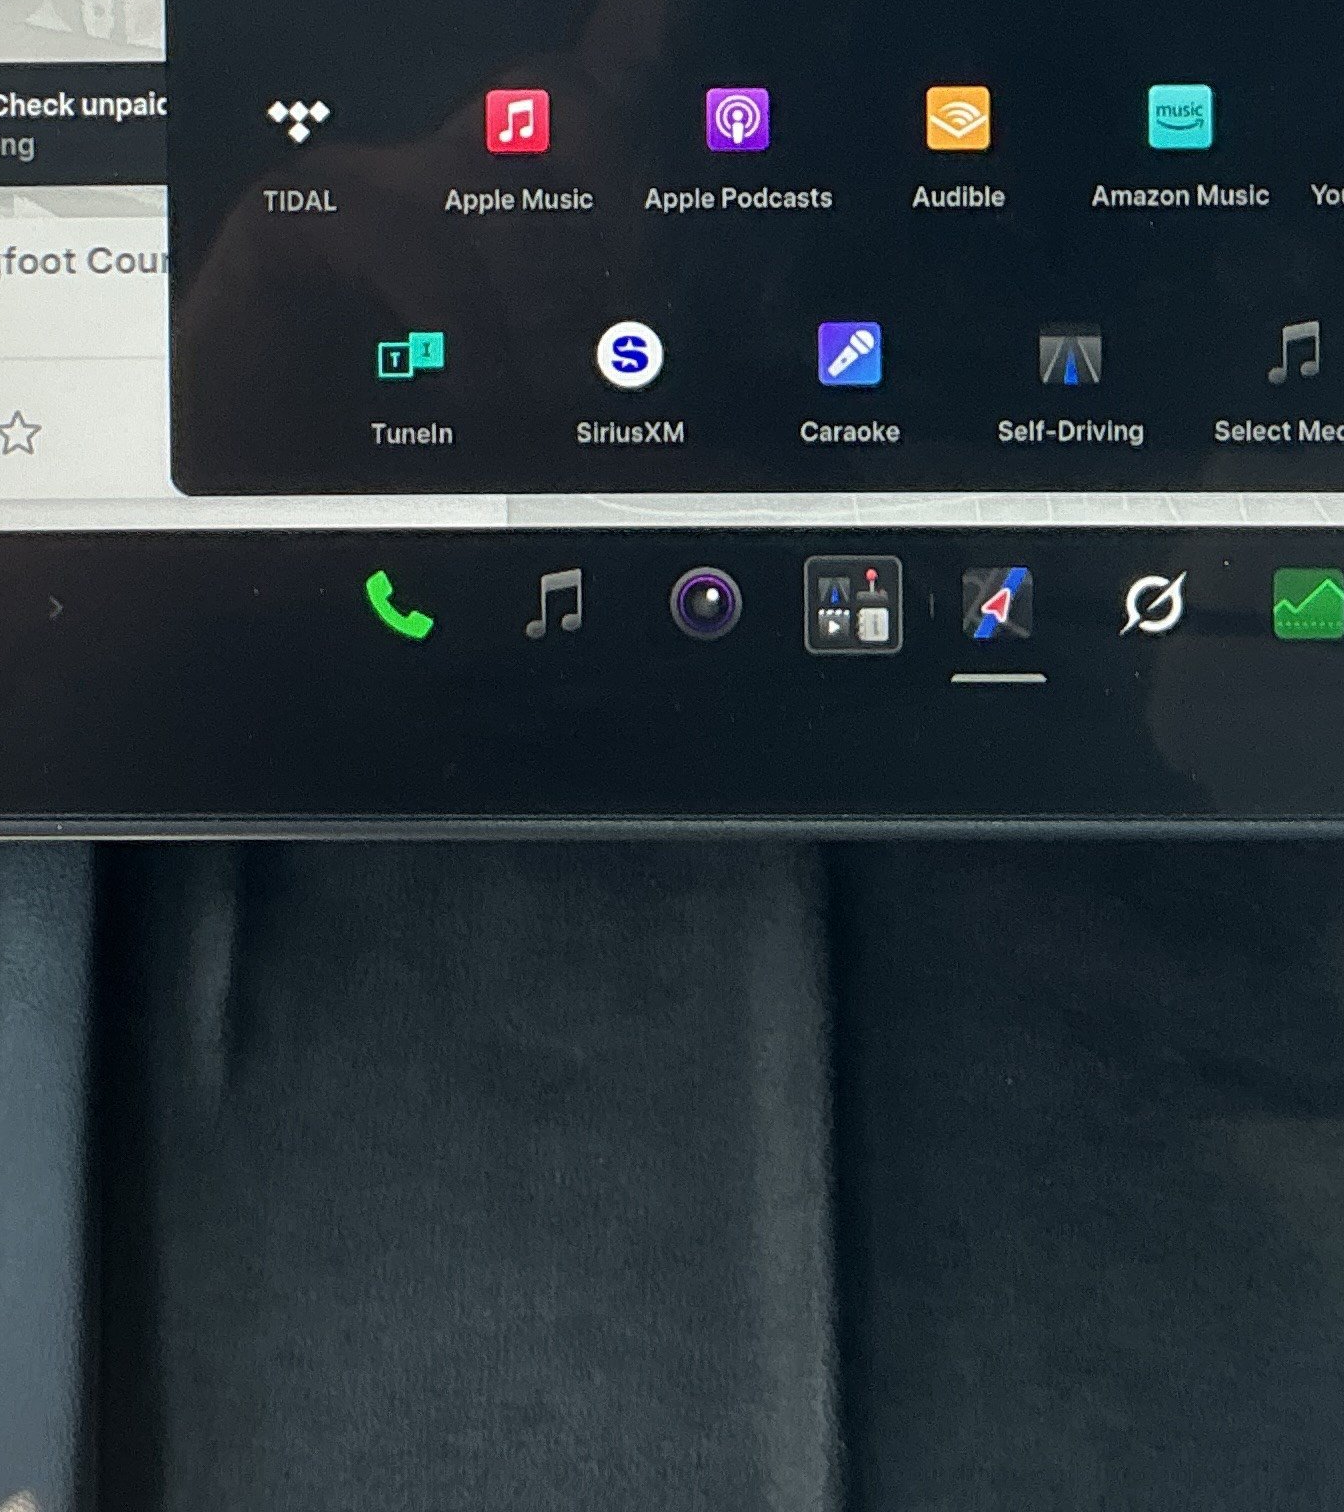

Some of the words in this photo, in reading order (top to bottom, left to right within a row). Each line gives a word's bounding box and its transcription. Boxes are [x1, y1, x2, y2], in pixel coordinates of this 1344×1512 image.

[1156, 102, 1204, 120] music
[262, 189, 338, 212] TIDAL
[444, 188, 515, 215] Apple
[522, 187, 594, 210] Music
[644, 187, 716, 214] Apple
[721, 186, 833, 209] Podcasts
[912, 185, 1006, 208] Audible
[1091, 184, 1190, 207] Amazon
[1198, 184, 1270, 207] Music
[370, 422, 453, 445] TuneIn
[576, 421, 685, 444] SiriusXM
[800, 420, 901, 443] Caraoke
[998, 419, 1144, 447] Self-Driving
[1214, 419, 1292, 442] Select
